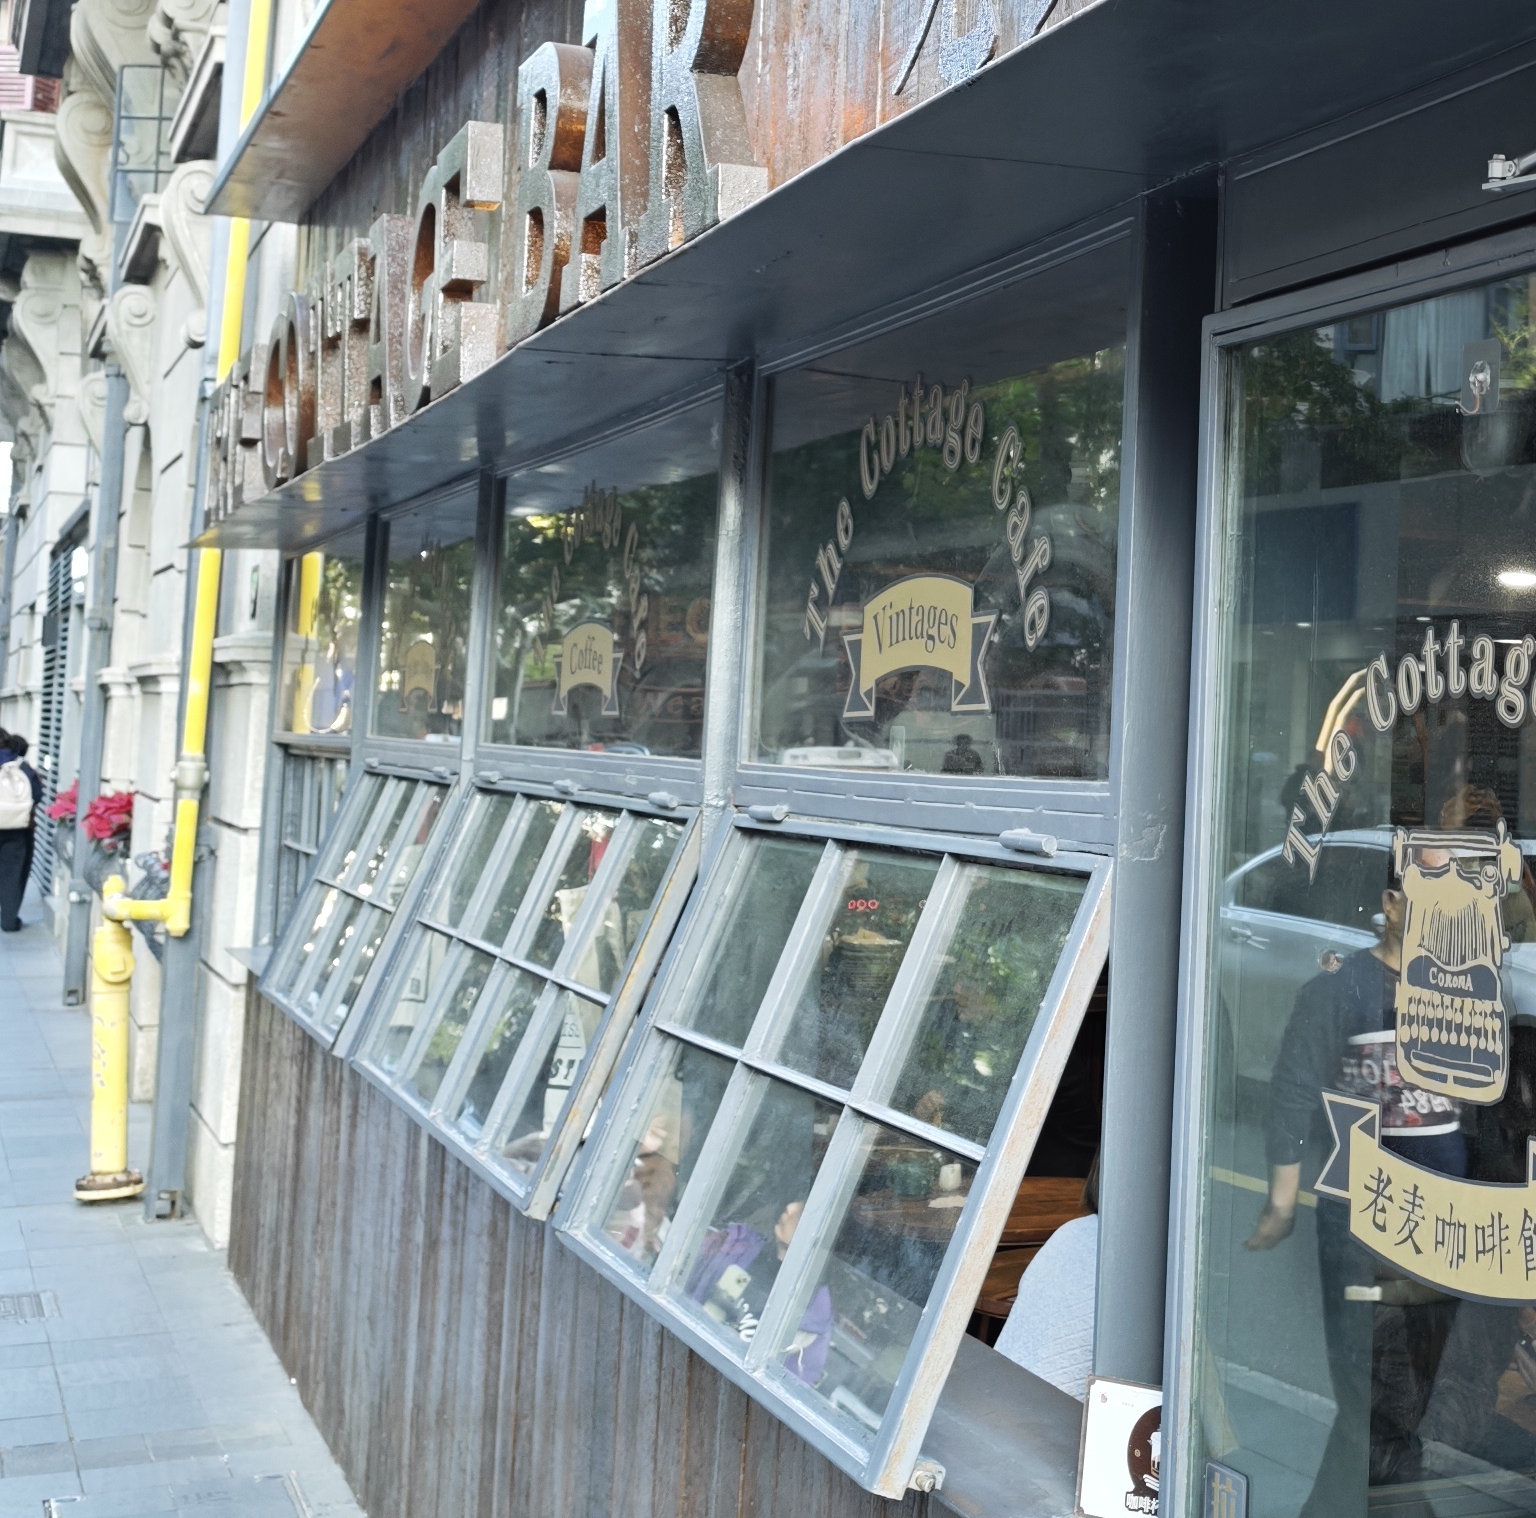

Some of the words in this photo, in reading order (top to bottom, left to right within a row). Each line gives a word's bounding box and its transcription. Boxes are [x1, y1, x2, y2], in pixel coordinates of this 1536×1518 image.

[804, 497, 853, 654] The
[860, 373, 985, 500] Cottage
[569, 636, 603, 675] Coffee
[872, 597, 959, 655] Vintages
[1283, 730, 1356, 883] The
